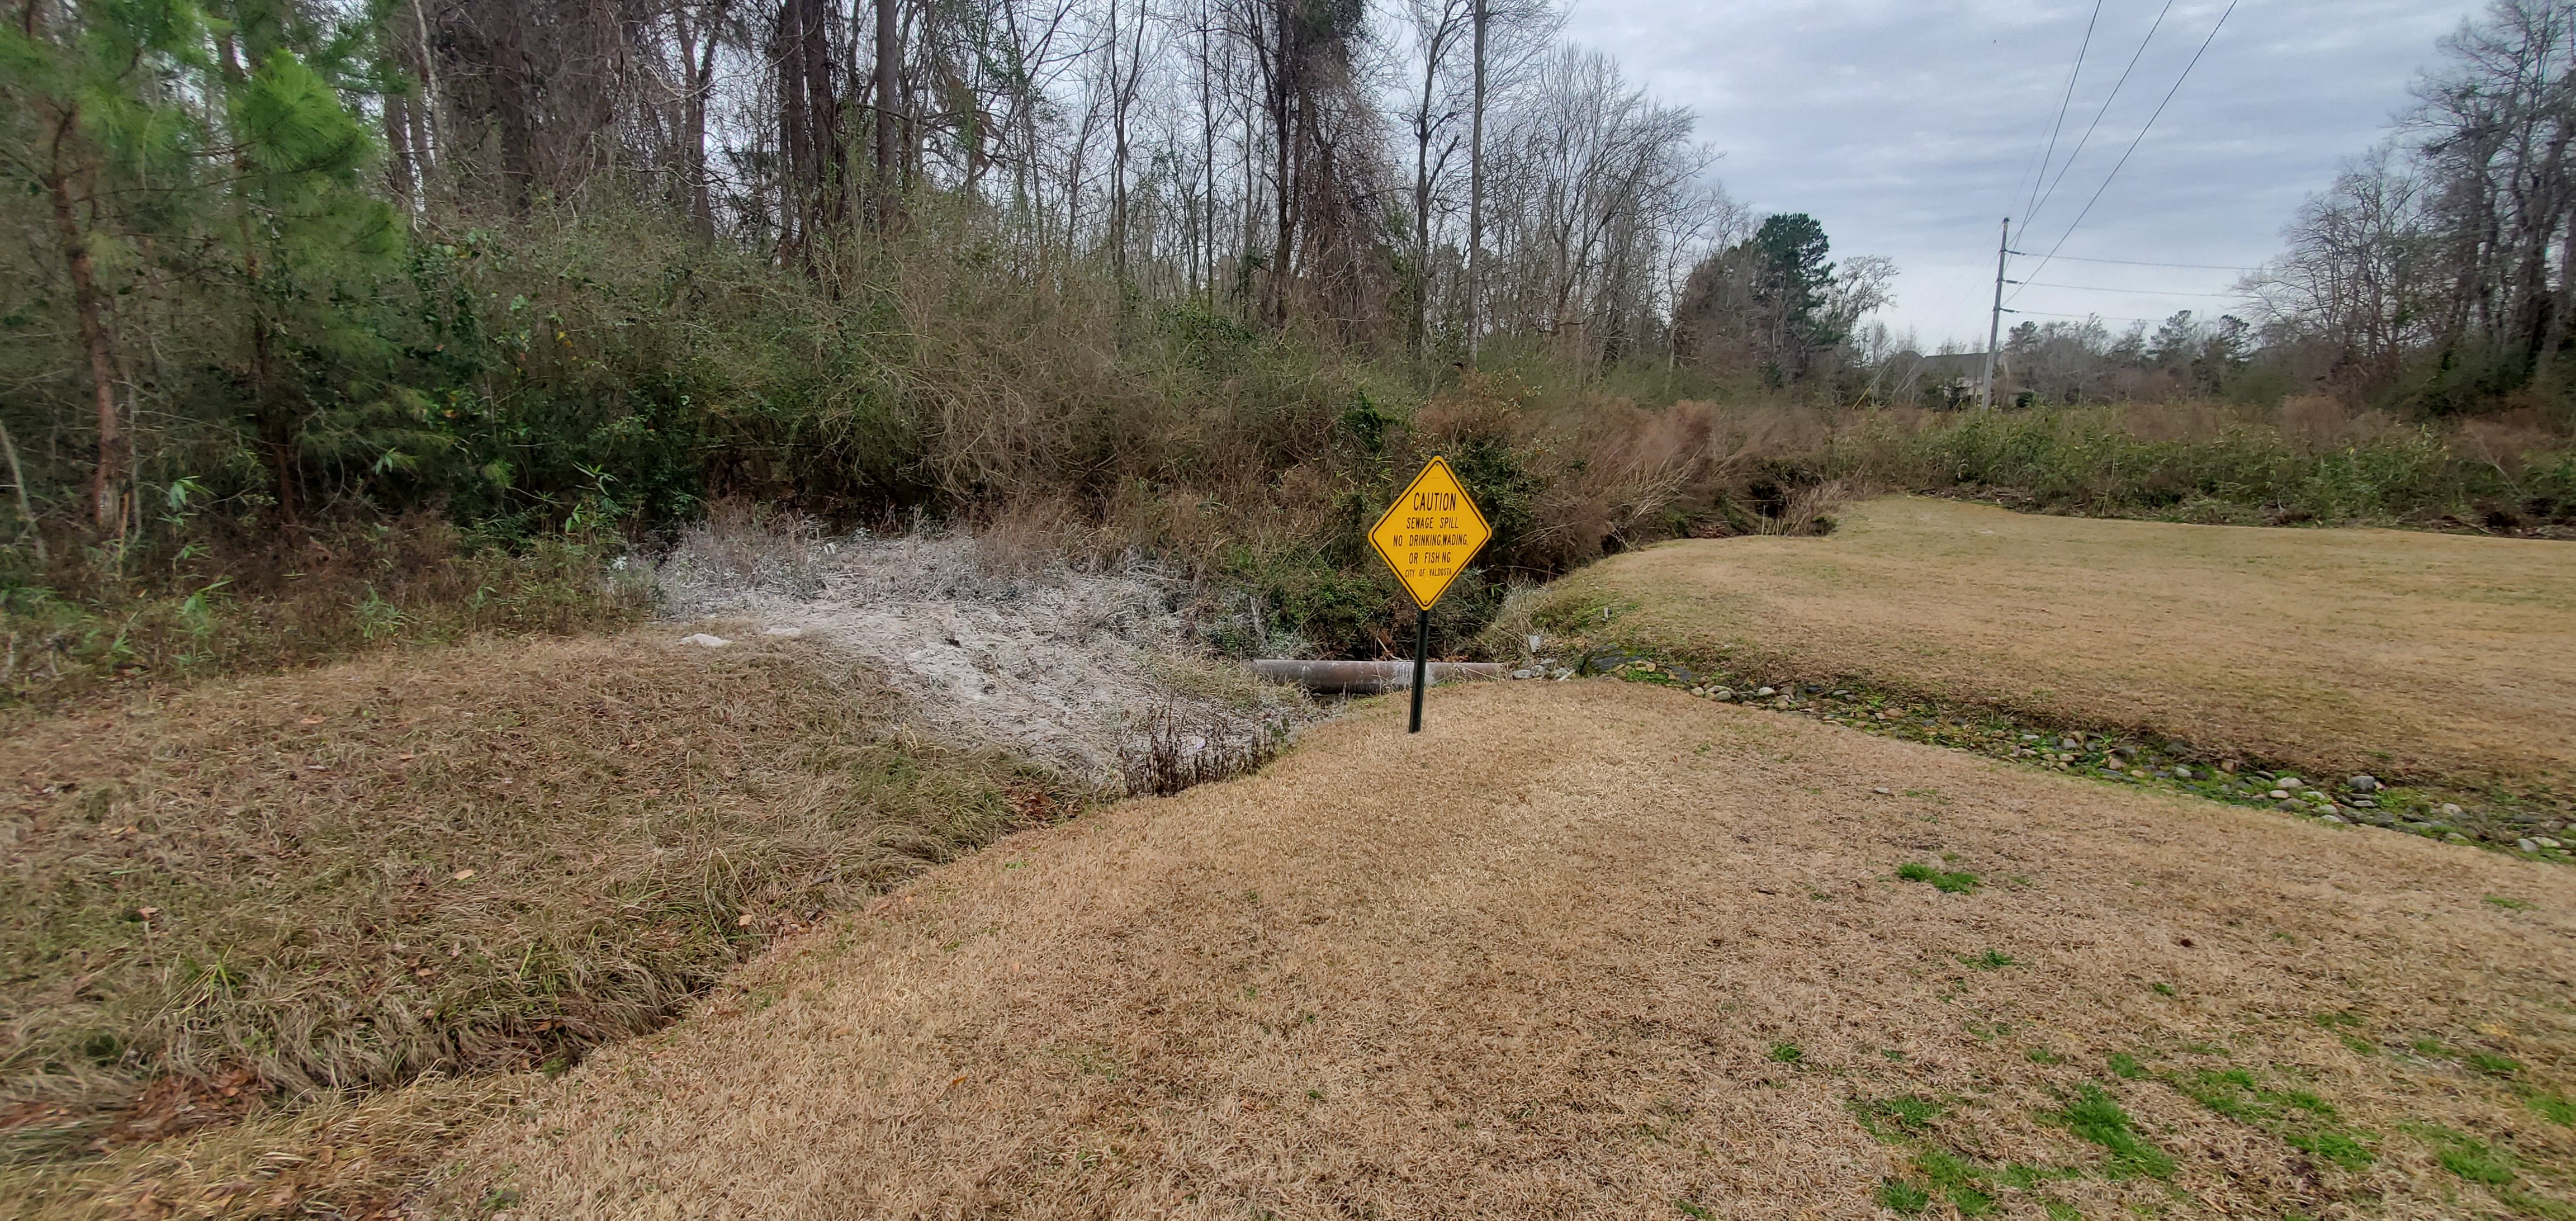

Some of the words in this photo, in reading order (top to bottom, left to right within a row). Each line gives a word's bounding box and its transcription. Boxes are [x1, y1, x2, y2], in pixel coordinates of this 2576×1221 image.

[1413, 492, 1457, 511] CAUTION
[1407, 517, 1434, 529] SEWAGE
[1440, 517, 1459, 529] SPILL
[1393, 534, 1403, 547] NO
[1409, 552, 1418, 564] OR
[1424, 551, 1451, 564] FISHNG
[1405, 569, 1415, 578] CITY
[1419, 569, 1425, 577] OF
[1429, 567, 1452, 576] VALDOSTA
